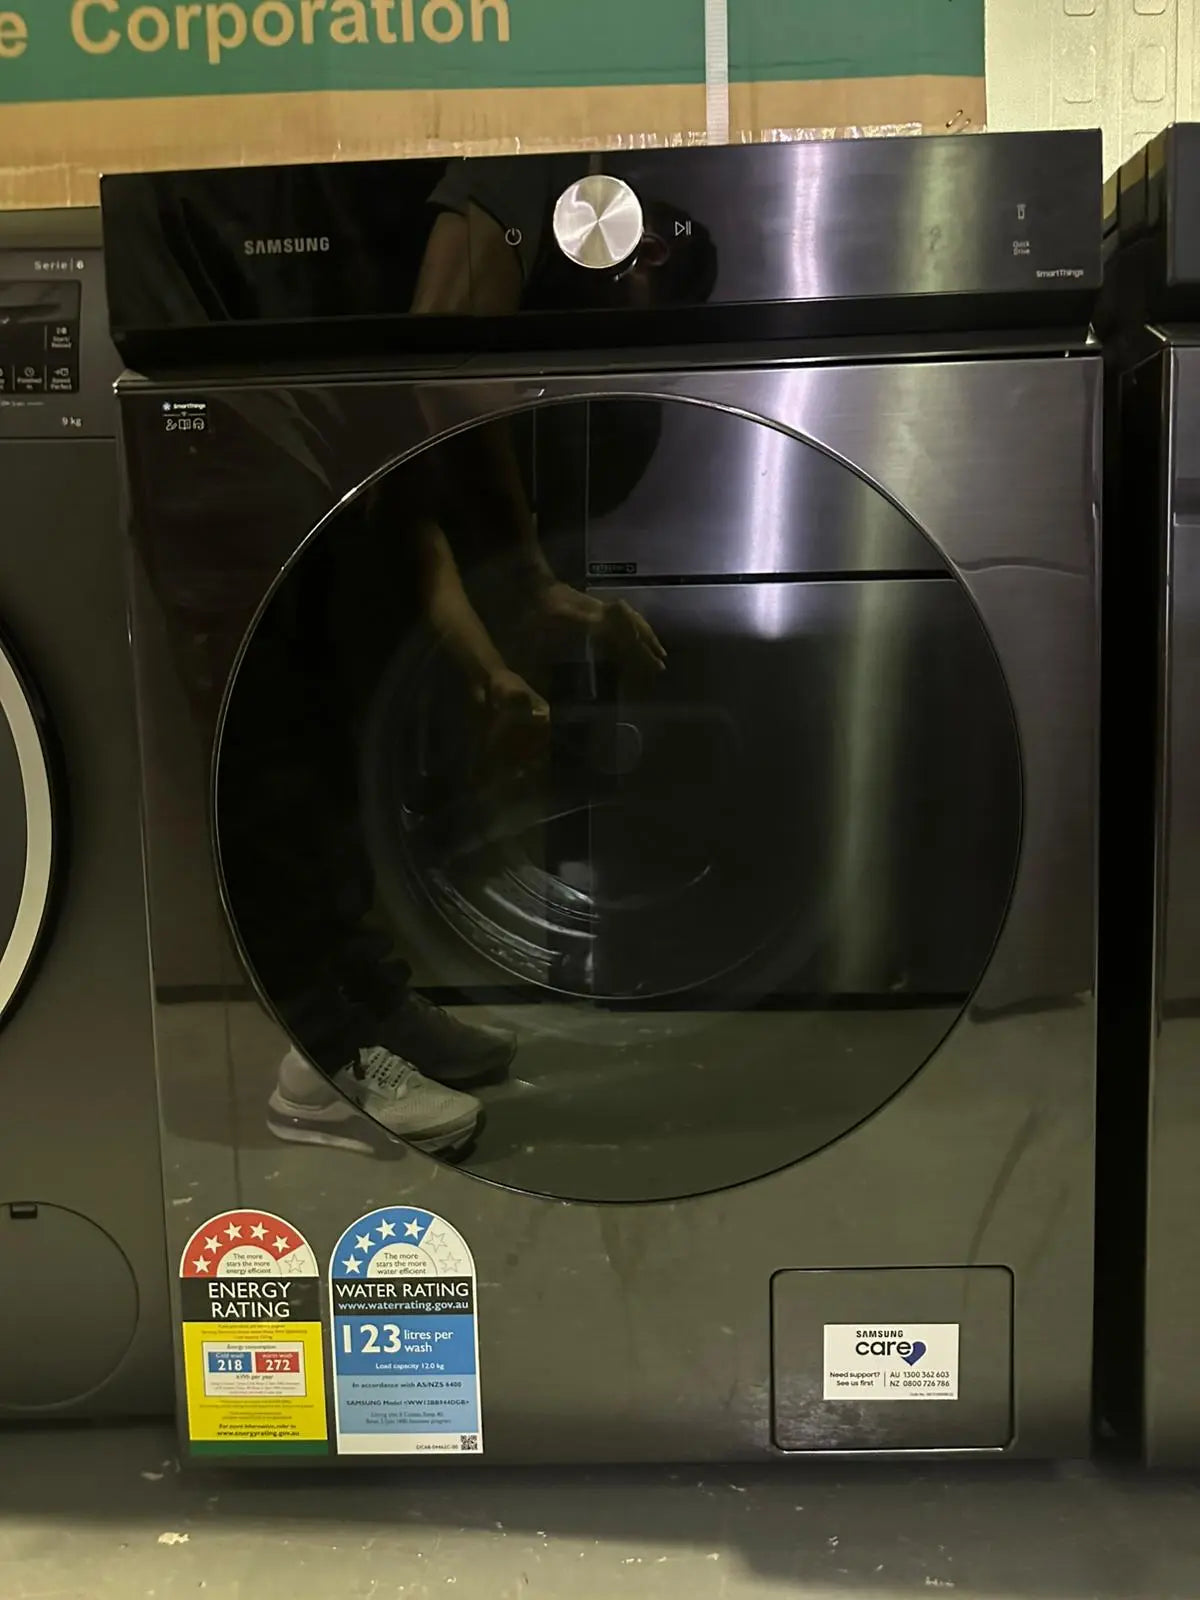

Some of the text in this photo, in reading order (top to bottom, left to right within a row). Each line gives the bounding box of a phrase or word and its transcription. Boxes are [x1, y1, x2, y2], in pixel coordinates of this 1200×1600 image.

[70, 0, 511, 65] Corporation
[244, 237, 330, 255] SAMSUNG
[34, 261, 68, 271] Serie
[1036, 269, 1084, 278] SmartThings
[62, 416, 82, 427] 9 kg
[208, 1281, 292, 1299] ENERGY
[336, 1282, 469, 1298] WATER RATING
[211, 1301, 290, 1318] RATING
[338, 1301, 469, 1311] www.waterrating.gov.au
[343, 1323, 401, 1353] 123
[404, 1329, 454, 1342] litres per
[856, 1330, 904, 1338] SAMSUNG
[404, 1342, 432, 1352] wash
[855, 1341, 912, 1356] care
[217, 1359, 243, 1371] 218
[265, 1359, 291, 1371] 272
[849, 1371, 881, 1379] support?
